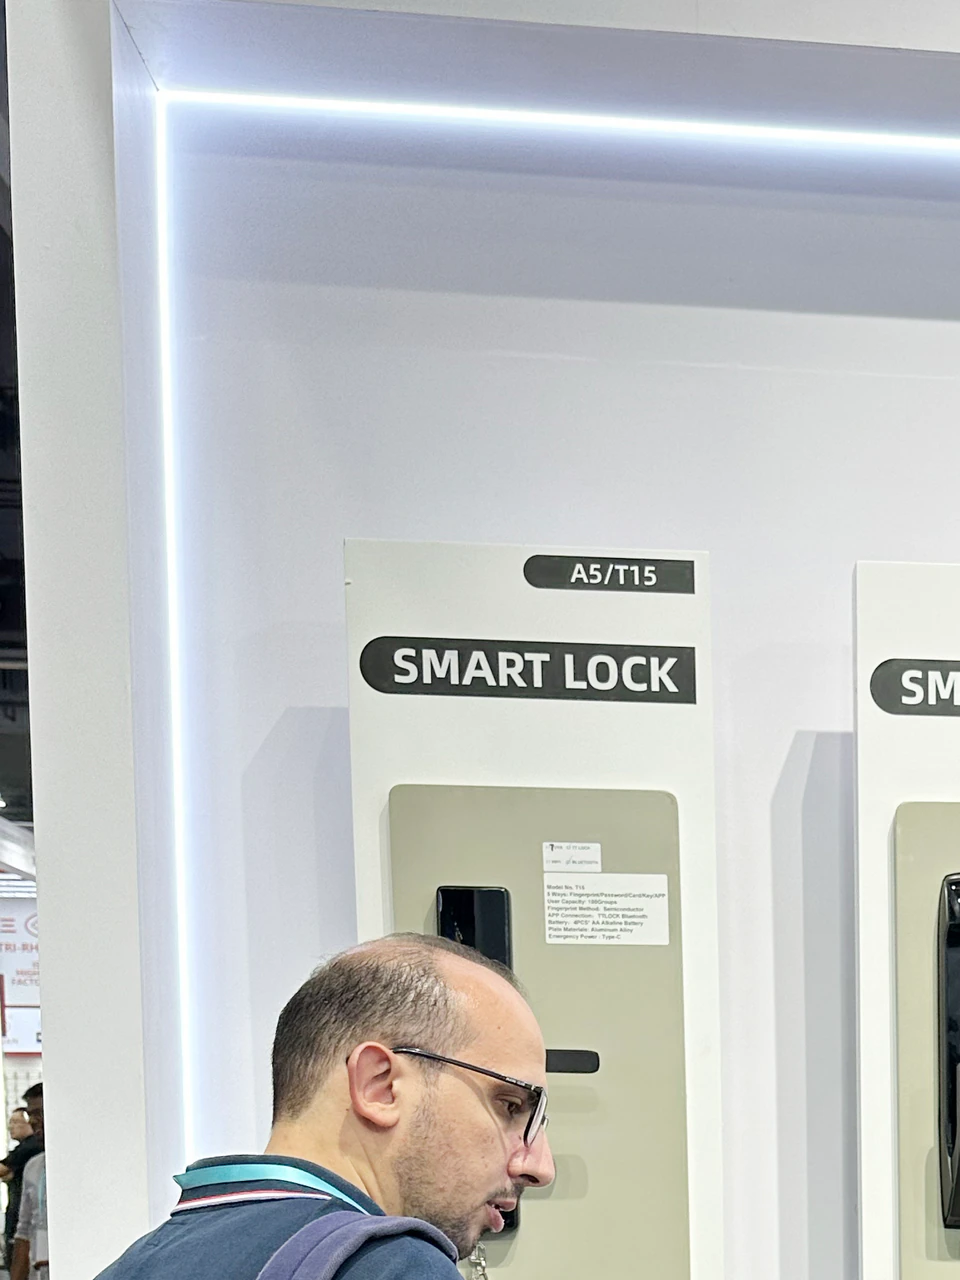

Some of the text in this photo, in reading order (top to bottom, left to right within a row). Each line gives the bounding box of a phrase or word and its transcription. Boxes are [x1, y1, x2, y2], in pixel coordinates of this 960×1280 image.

[570, 563, 657, 586] A5/T15
[393, 647, 680, 693] SMART LOCK
